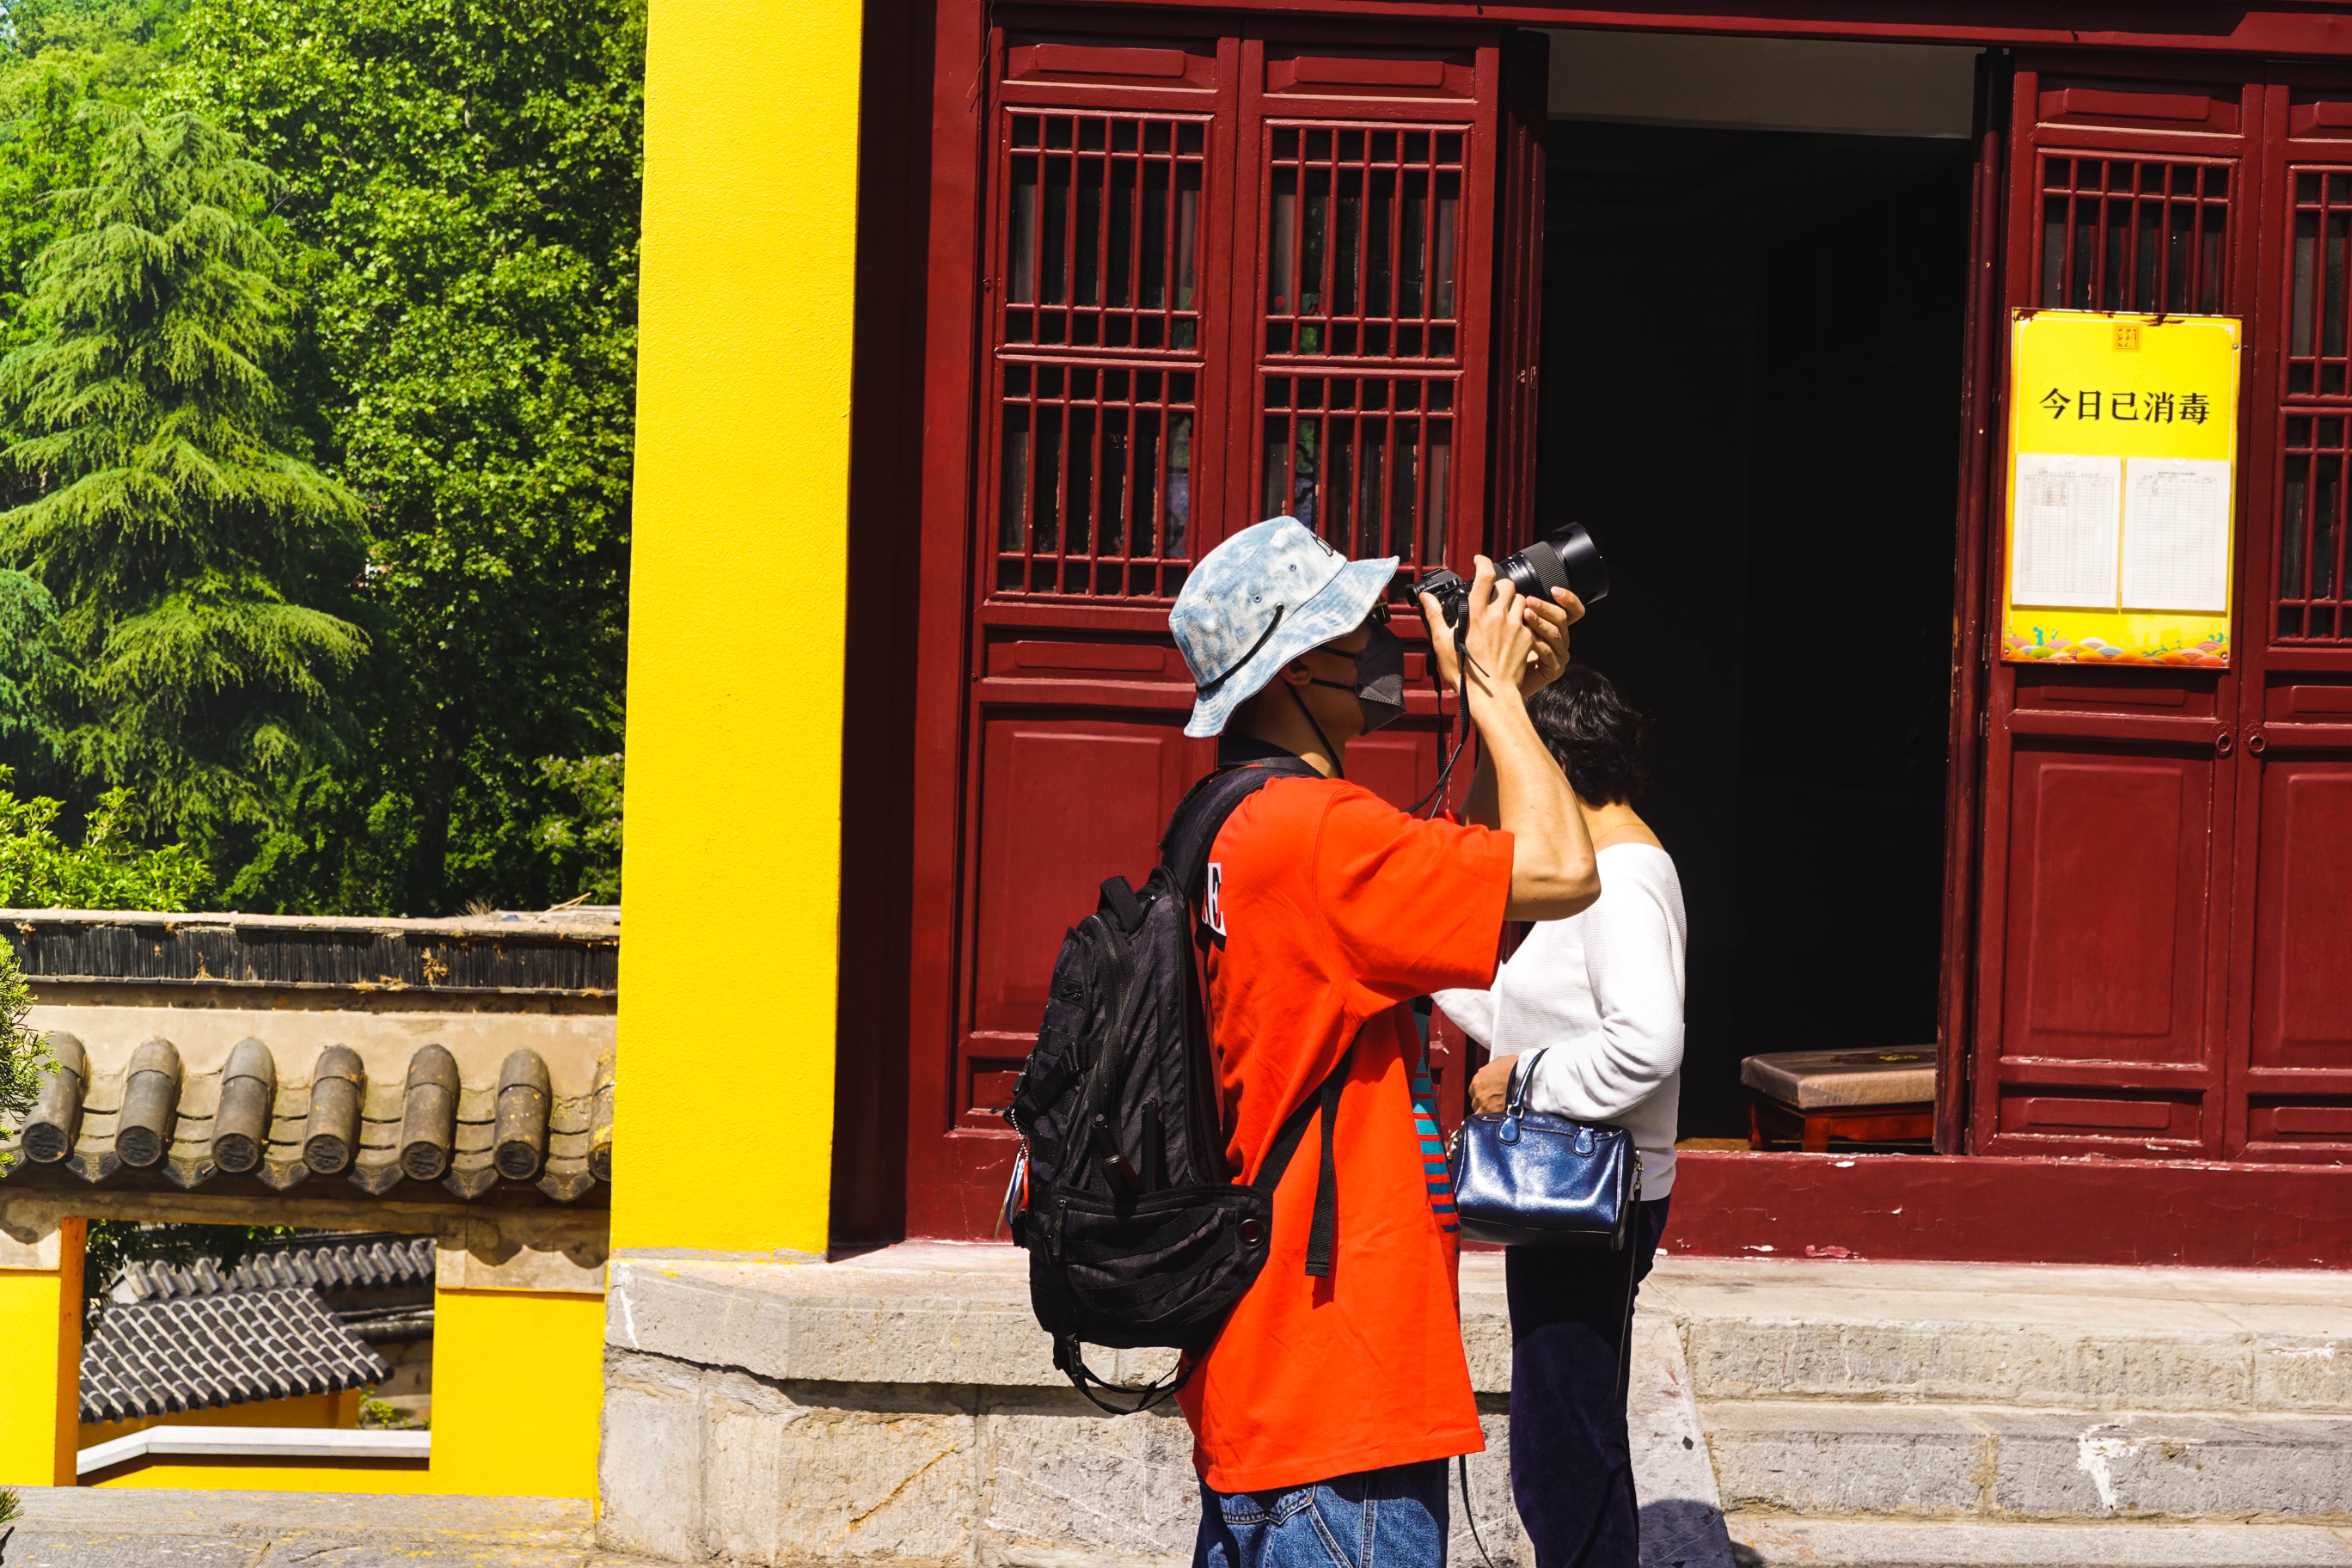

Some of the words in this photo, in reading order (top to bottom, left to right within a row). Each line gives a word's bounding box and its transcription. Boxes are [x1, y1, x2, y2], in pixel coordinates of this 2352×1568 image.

[2039, 387, 2210, 425] 今日已消毒
[1201, 862, 1228, 938] E
